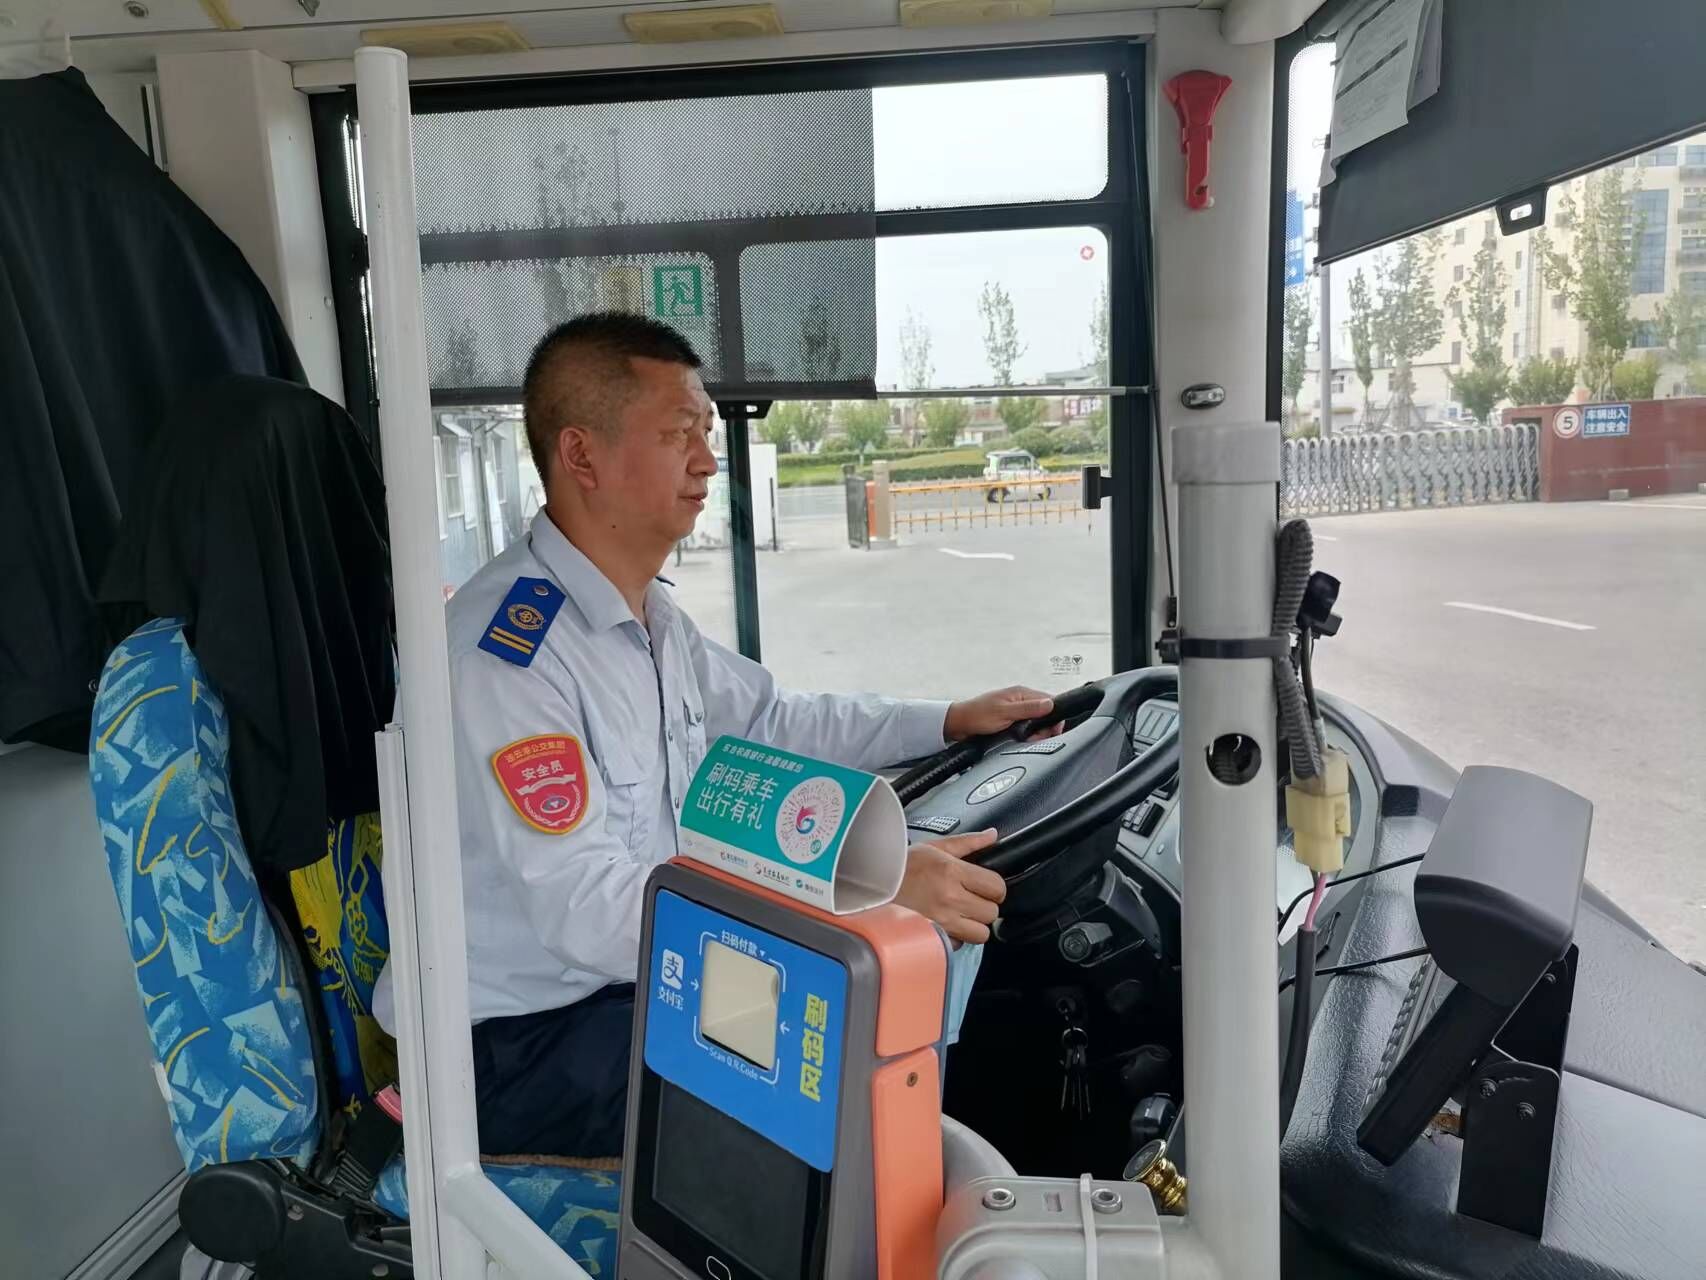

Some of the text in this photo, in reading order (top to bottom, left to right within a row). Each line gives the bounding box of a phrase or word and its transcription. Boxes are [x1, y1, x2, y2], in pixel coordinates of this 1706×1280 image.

[1563, 416, 1573, 430] 5
[1586, 407, 1628, 420] 车辆出入
[1585, 421, 1626, 434] 注意安全
[521, 759, 565, 781] 安全员
[706, 762, 779, 802] 刷码乘车
[696, 786, 764, 830] 出行有礼
[721, 929, 758, 958] 扫码付款
[657, 985, 684, 1011] 支付宝
[708, 1046, 726, 1064] Scan
[800, 992, 828, 1103] 刷码区
